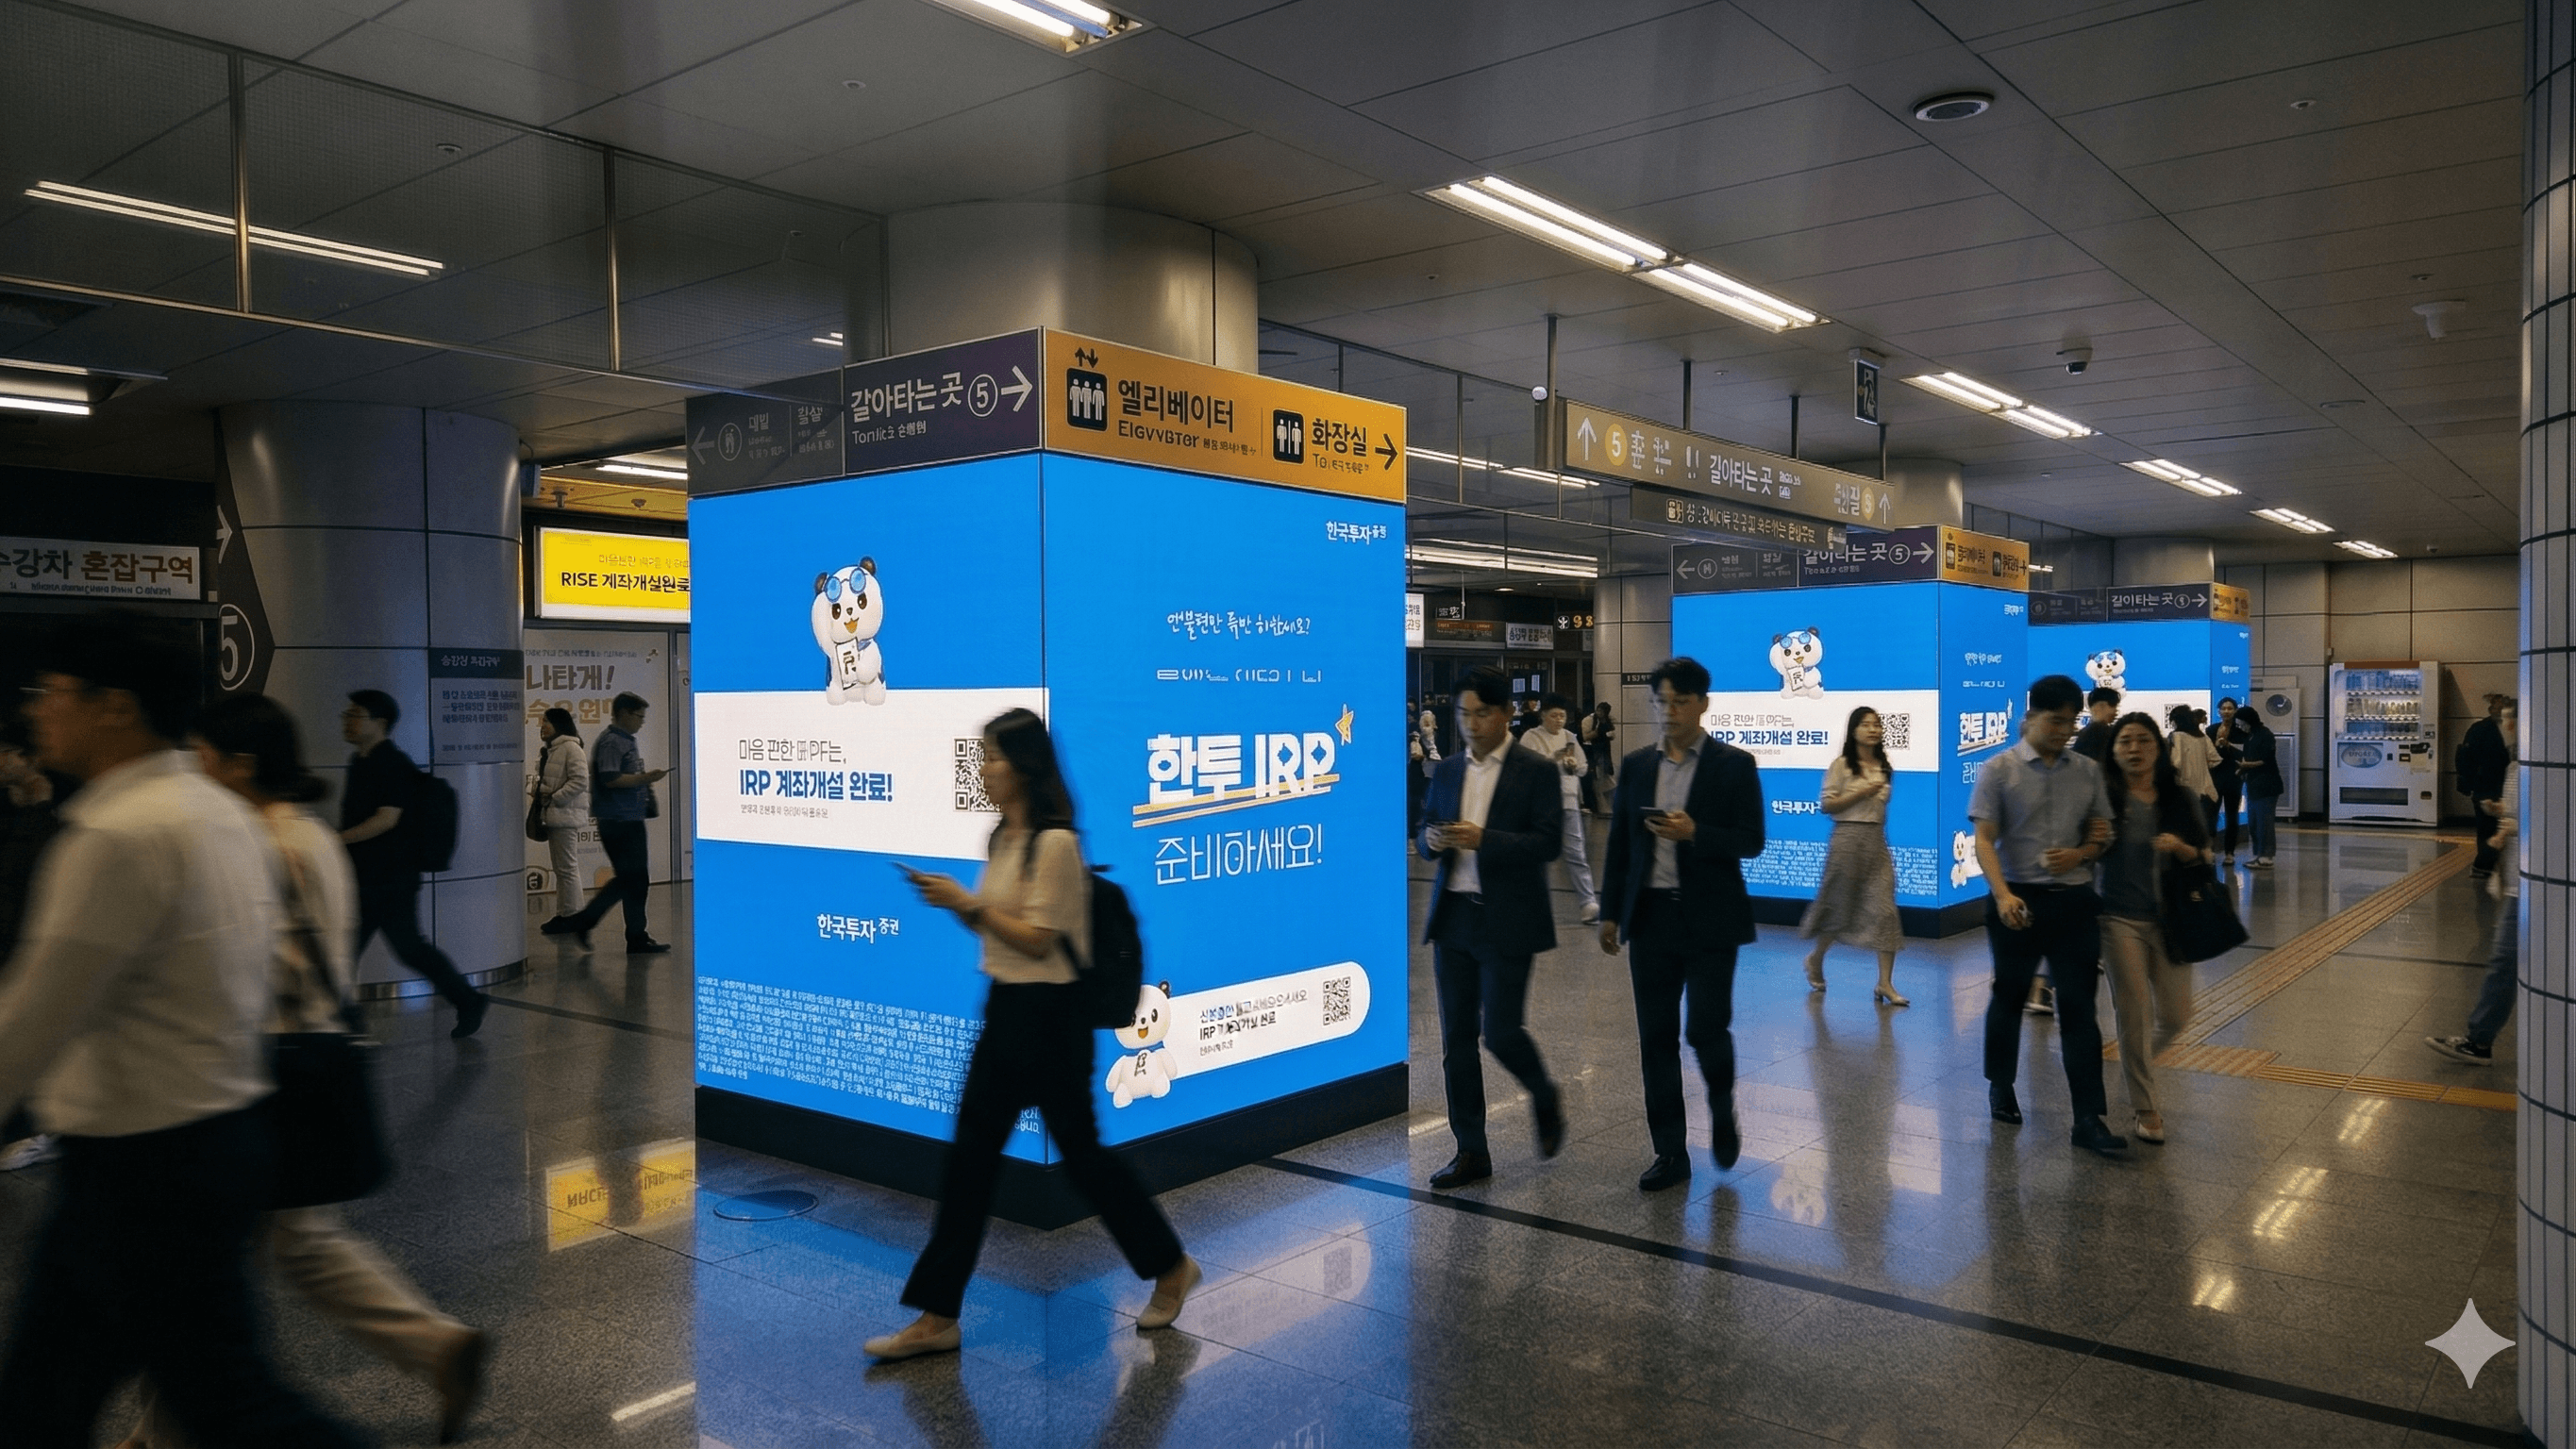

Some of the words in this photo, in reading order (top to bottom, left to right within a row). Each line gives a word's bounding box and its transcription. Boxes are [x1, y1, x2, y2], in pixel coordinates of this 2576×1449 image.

[851, 378, 937, 424] 갈아타는
[941, 372, 963, 408] 곳
[1118, 379, 1233, 434] 엘리베이터
[1312, 417, 1367, 457] 화장실
[1760, 466, 1773, 495] 곳
[1326, 521, 1373, 545] 한국투자
[80, 550, 193, 584] 혼잡구역
[1870, 542, 1888, 561] 곳
[561, 572, 598, 587] RISE
[221, 615, 238, 681] 5
[1797, 730, 1829, 745] 완료!
[1146, 733, 1242, 805] 한투
[1254, 732, 1335, 799] IRP
[740, 769, 771, 796] IRP
[776, 769, 844, 800] 계좌개설
[849, 771, 893, 802] 완료!
[816, 913, 876, 943] 한국투자
[1199, 1025, 1216, 1041] IRP
